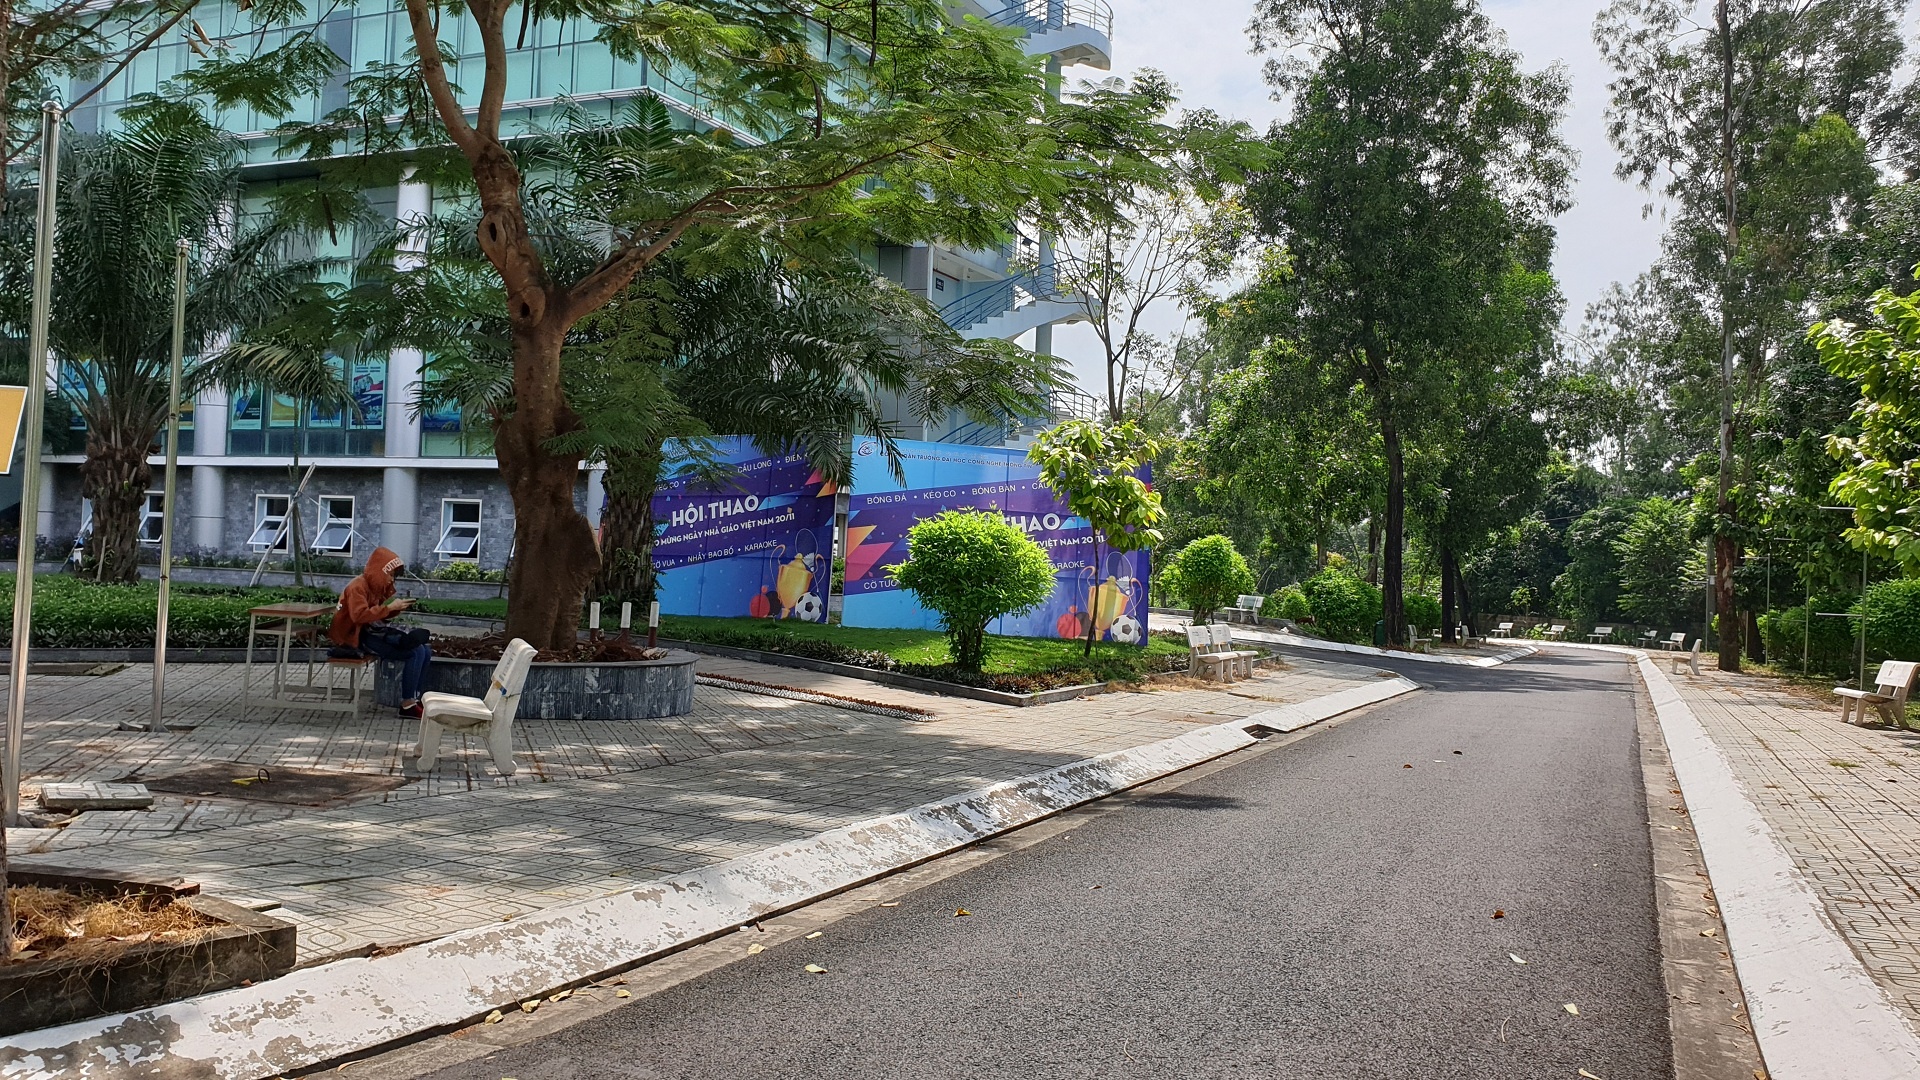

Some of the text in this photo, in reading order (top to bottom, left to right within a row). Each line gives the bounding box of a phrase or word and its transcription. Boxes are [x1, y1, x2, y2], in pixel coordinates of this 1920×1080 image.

[867, 494, 893, 505] BÓNG
[894, 492, 907, 502] ĐÁ
[923, 489, 942, 500] KÉO
[943, 489, 957, 498] CO
[972, 485, 997, 496] BÓNG
[998, 482, 1016, 493] BÀN
[672, 494, 759, 529] HỘI THAO
[660, 535, 682, 546] MỪNG
[683, 530, 703, 541] NGÀY
[704, 525, 720, 537] NHÀ
[720, 522, 739, 534] GIÁO
[740, 520, 756, 530] VIỆT
[757, 517, 774, 527] NAM
[775, 512, 795, 523] 20/11
[1039, 534, 1104, 549] VIỆT NAM 2011
[662, 559, 676, 568] VUA
[708, 548, 723, 559] BAO
[744, 539, 778, 552] KARAOKE
[863, 580, 878, 590] CỜ
